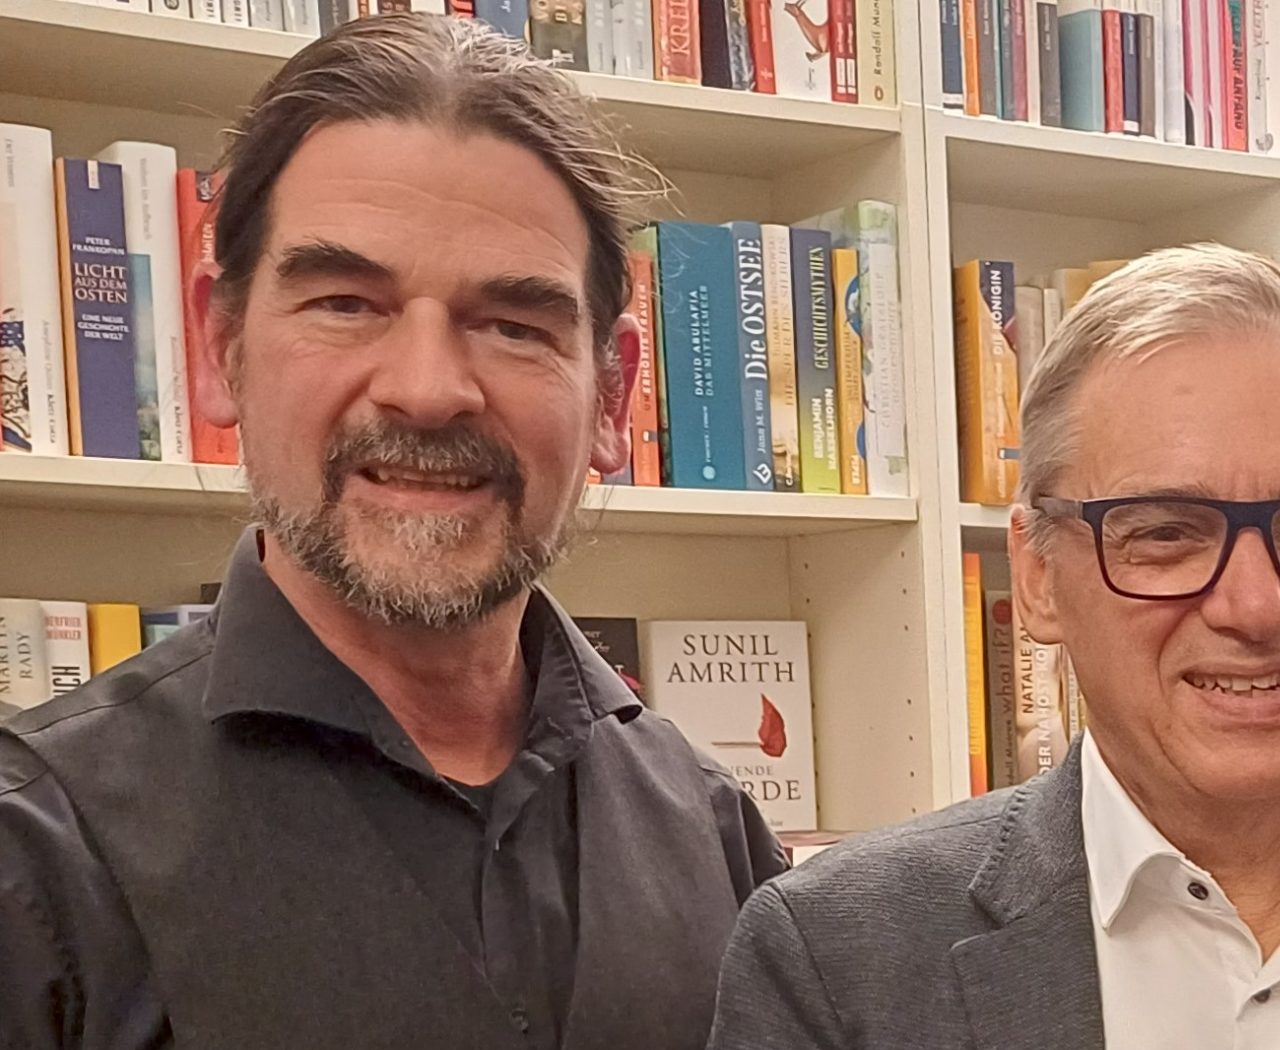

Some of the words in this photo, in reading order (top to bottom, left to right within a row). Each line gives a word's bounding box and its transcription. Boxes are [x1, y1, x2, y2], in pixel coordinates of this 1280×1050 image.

[74, 262, 127, 279] LICHT
[75, 277, 98, 288] AUS
[100, 278, 128, 291] DEM
[737, 238, 765, 335] OSTSEE
[75, 288, 128, 304] OSTEN
[808, 246, 830, 370] GESCHICHTSMYTHEN
[688, 289, 702, 354] ABULAFIA
[698, 285, 713, 368] MITTELMEER
[694, 357, 704, 396] DAVID
[743, 339, 767, 381] Die
[811, 398, 825, 459] BENJAMIN
[17, 632, 33, 680] RADY
[683, 634, 778, 655] SUNIL
[667, 661, 795, 683] AMRITH
[995, 663, 1014, 715] what
[1020, 650, 1034, 713] NATALIE
[731, 765, 774, 776] ENDE
[741, 780, 801, 801] RDE
